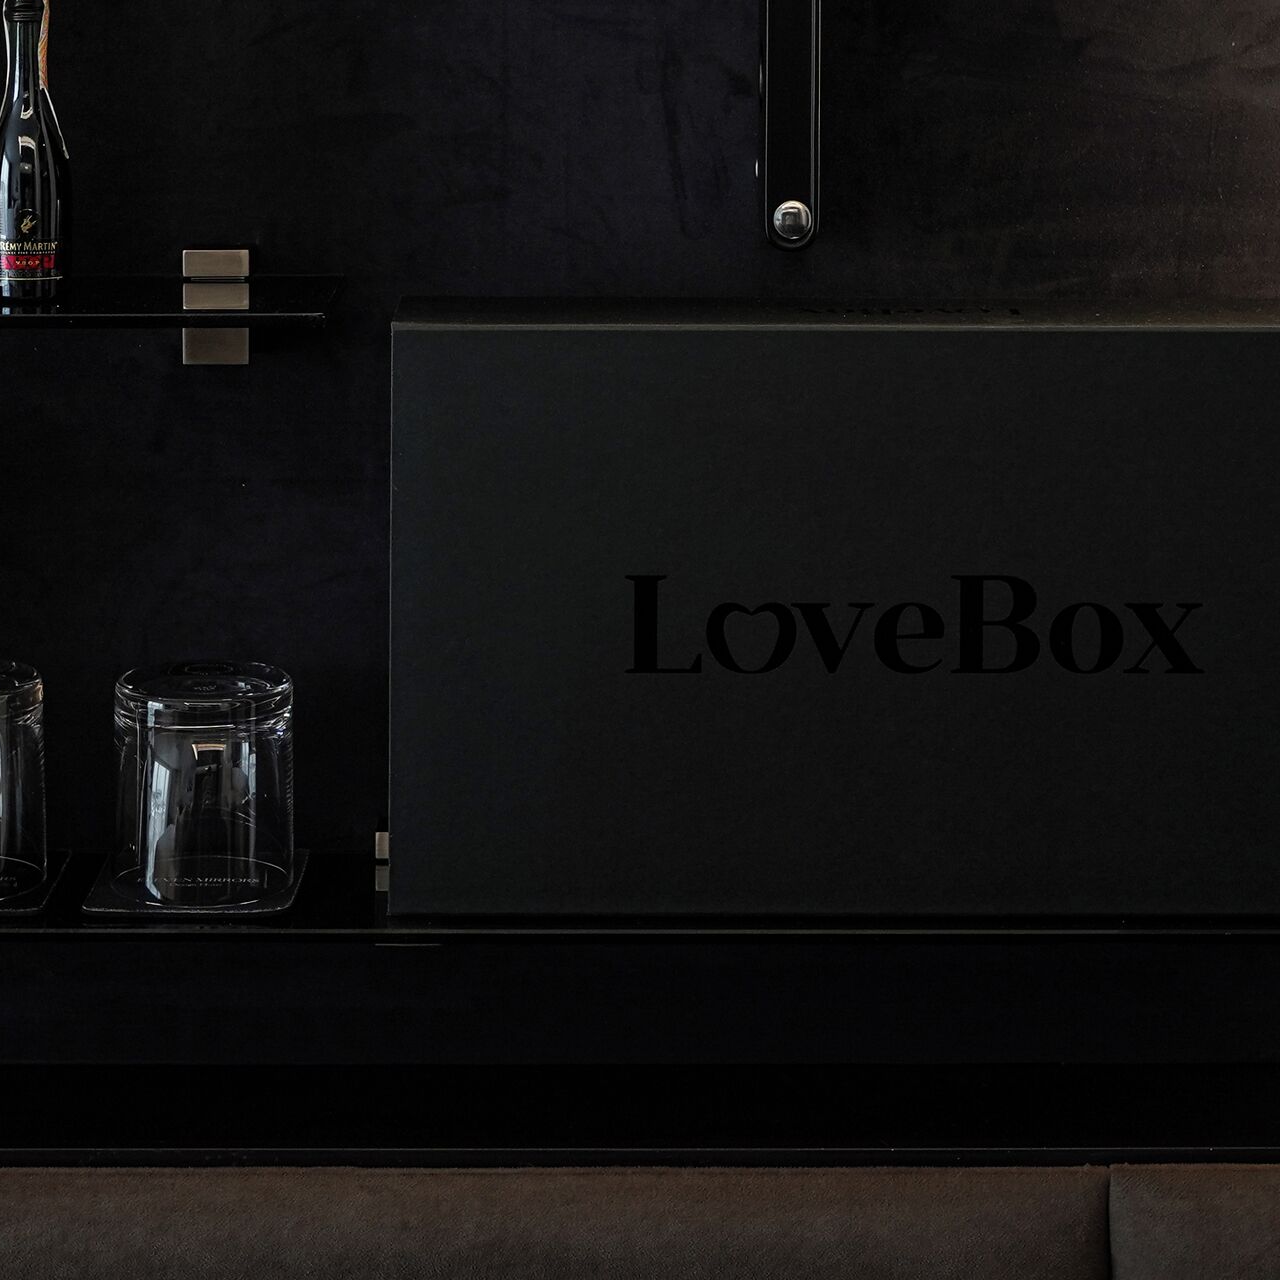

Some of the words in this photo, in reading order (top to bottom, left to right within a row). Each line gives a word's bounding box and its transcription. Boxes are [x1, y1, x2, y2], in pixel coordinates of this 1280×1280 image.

[0, 241, 22, 251] RÉMY
[23, 241, 56, 251] MARTIN
[624, 573, 1206, 677] LoveBox
